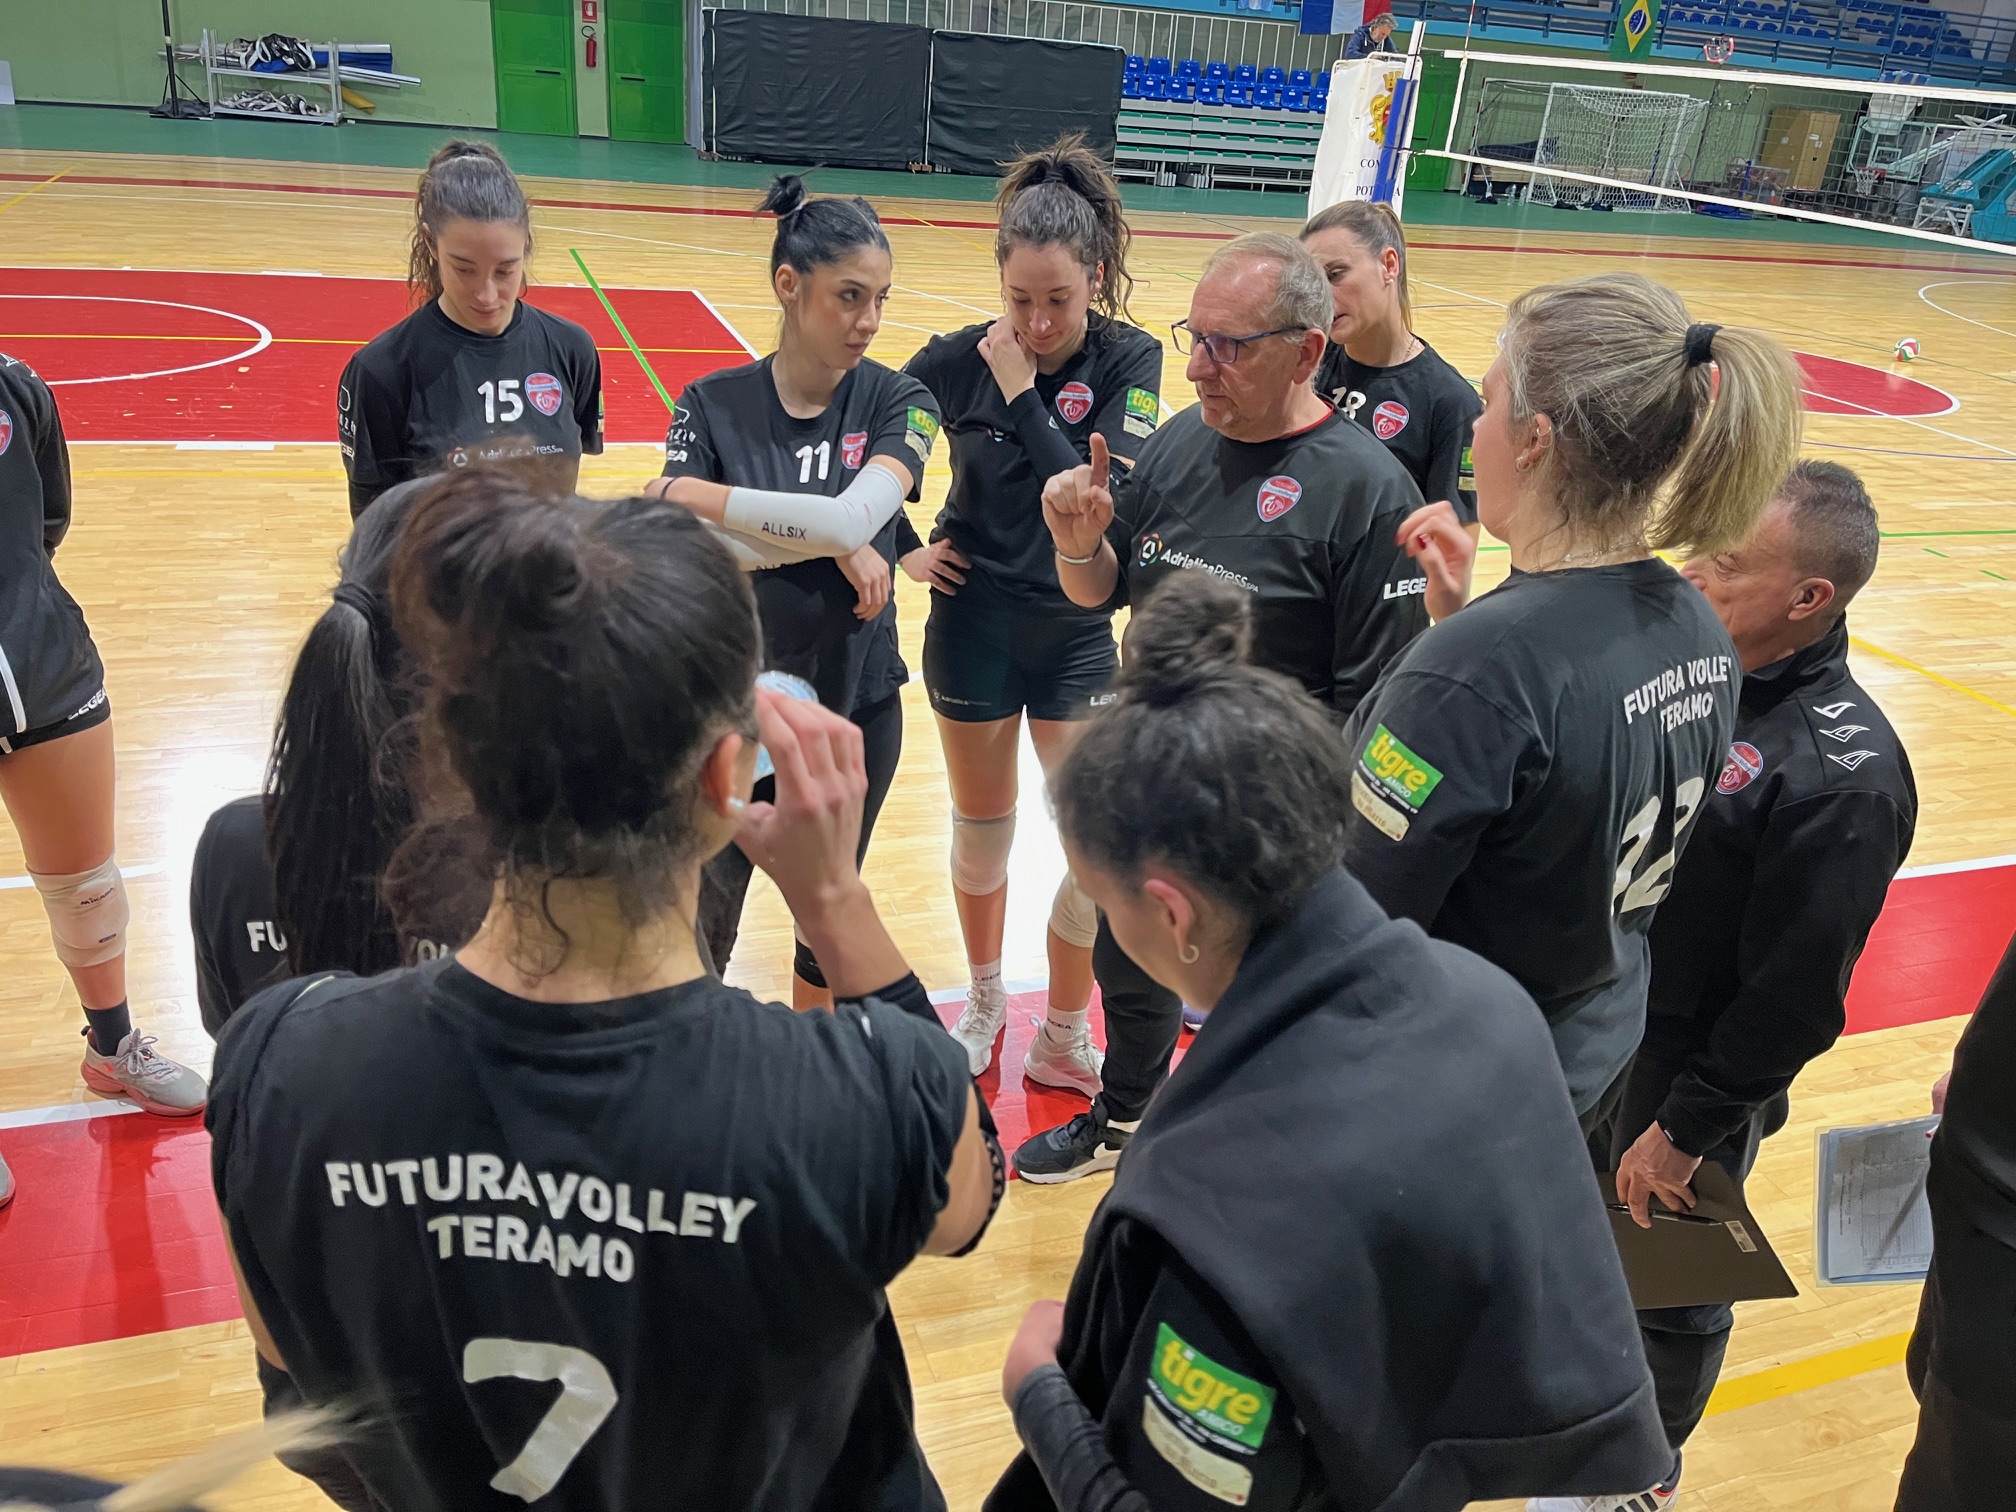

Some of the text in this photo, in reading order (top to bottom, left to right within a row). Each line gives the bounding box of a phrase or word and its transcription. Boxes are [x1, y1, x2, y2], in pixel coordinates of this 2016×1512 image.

[477, 380, 524, 424] 15
[1332, 386, 1367, 420] 18
[795, 440, 831, 484] 11
[761, 521, 808, 541] ALLSIX
[1383, 577, 1428, 600] LEGE
[1623, 655, 1732, 725] FUTURA VOLLE
[1661, 692, 1714, 736] TERAMO
[1370, 733, 1428, 792] tigre
[324, 1153, 757, 1244] FUTURA VOLLEY
[426, 1213, 636, 1284] TERAMO
[1160, 1340, 1262, 1425] tigre
[462, 1337, 620, 1504] 7
